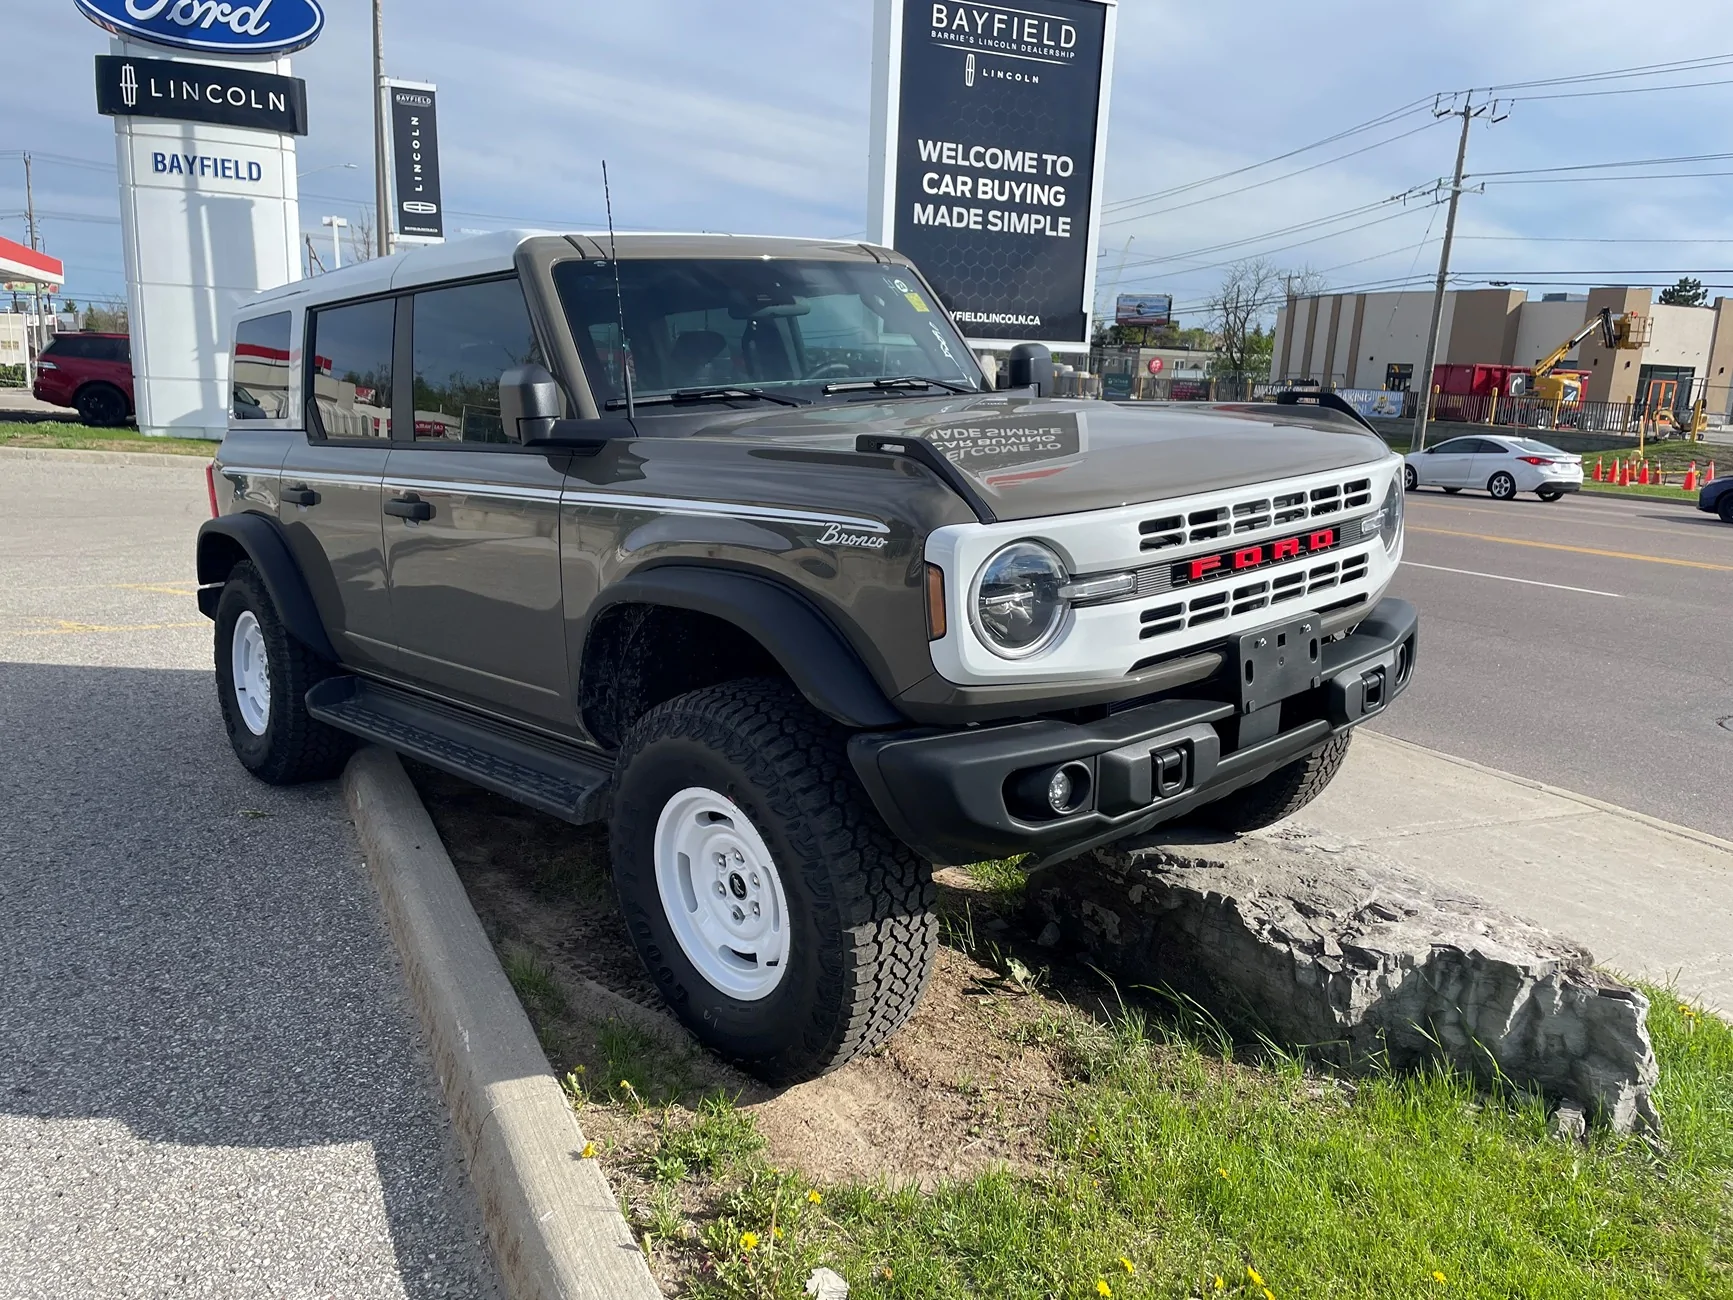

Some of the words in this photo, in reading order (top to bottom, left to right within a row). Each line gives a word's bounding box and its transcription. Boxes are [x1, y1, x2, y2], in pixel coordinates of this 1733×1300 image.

[931, 3, 1077, 49] BAYFIELD
[930, 30, 975, 44] BARRIE'S
[978, 38, 1017, 51] LINCOLN
[1021, 44, 1076, 59] DEALERSHIP
[982, 68, 1040, 84] LINCOLN
[150, 77, 286, 112] LINCOLN
[395, 94, 432, 105] BAYFIELD
[152, 151, 262, 183] BAYFIELD
[410, 116, 423, 192] LINCOLN
[917, 139, 1039, 175] WELCOME
[1042, 154, 1074, 178] TO
[922, 171, 973, 199] CAR
[977, 177, 1066, 207] BUYING
[913, 202, 983, 231] MADE
[986, 209, 1072, 238] SIMPLE
[949, 311, 1041, 326] YFIELDLINCOLN.CA
[816, 522, 889, 548] Bronco
[1188, 529, 1334, 580] FORD
